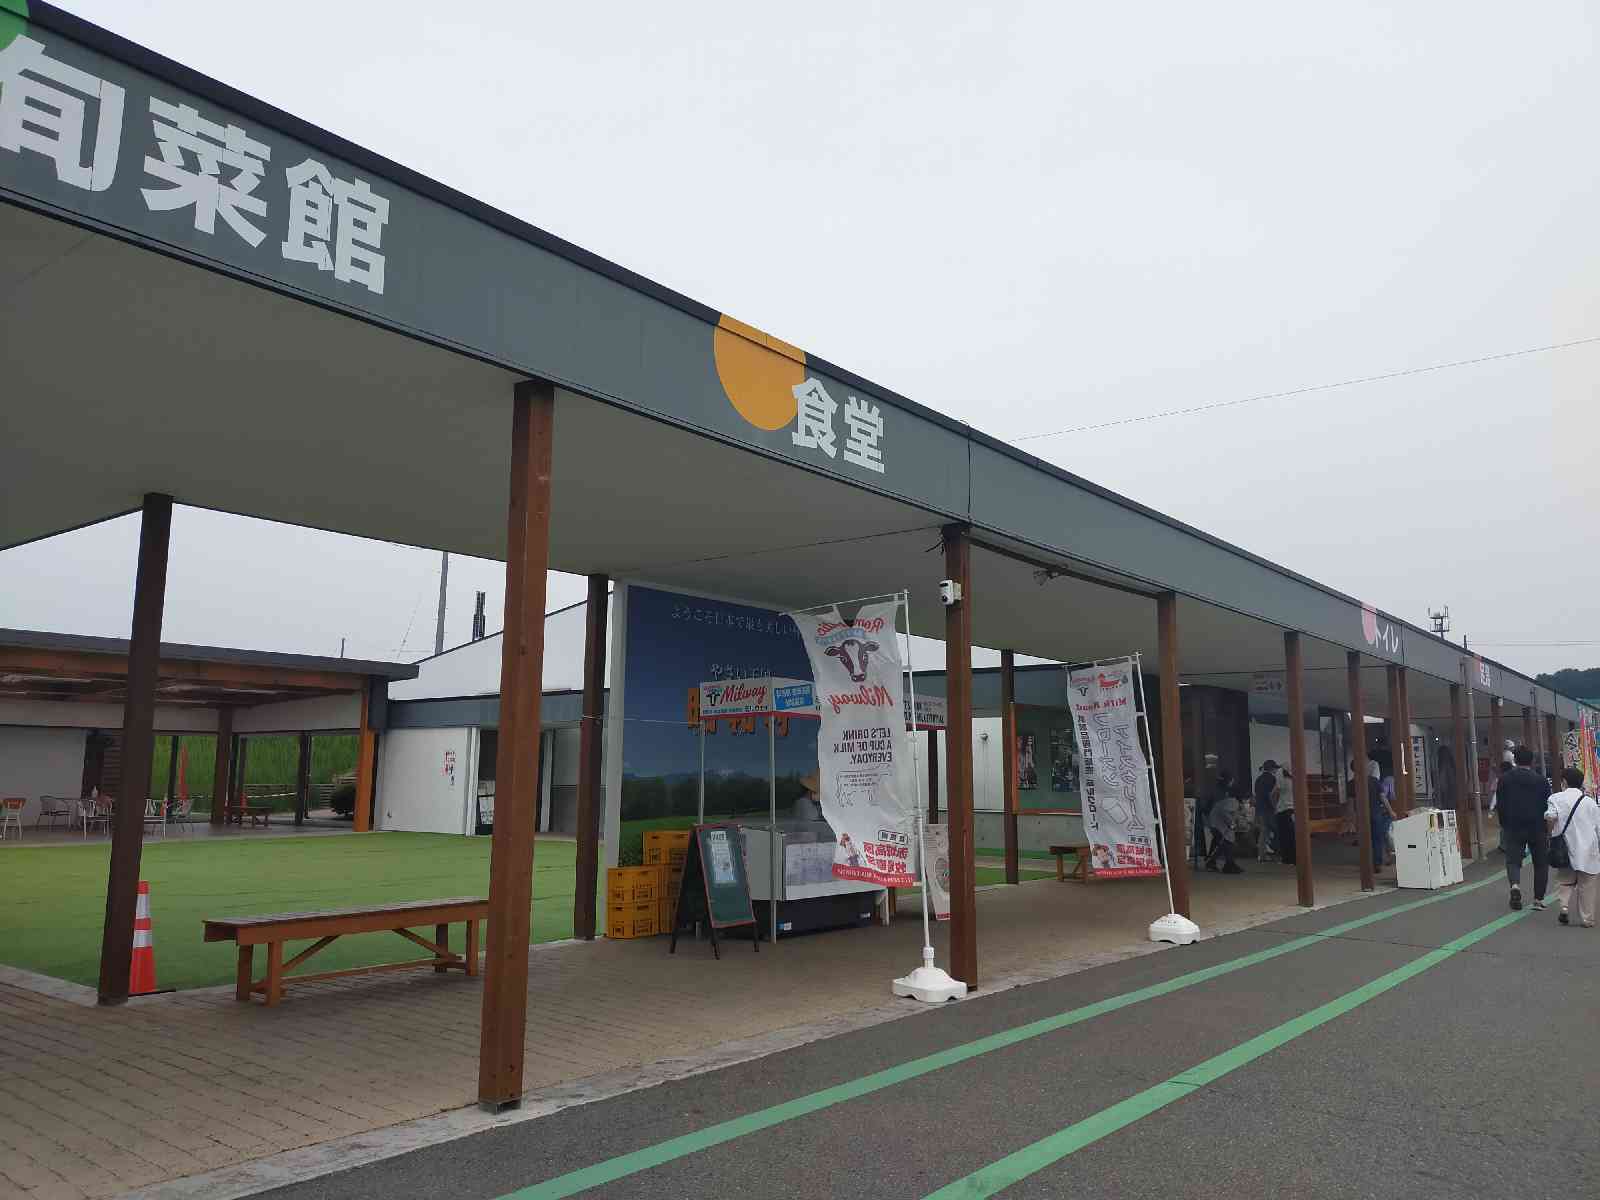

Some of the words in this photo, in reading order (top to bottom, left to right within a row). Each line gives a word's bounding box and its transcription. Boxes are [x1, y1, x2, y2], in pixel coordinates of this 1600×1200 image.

[0, 34, 390, 294] 旬菜館
[791, 377, 885, 473] 食堂
[1374, 622, 1399, 653] トイレ
[720, 683, 767, 706] Milway
